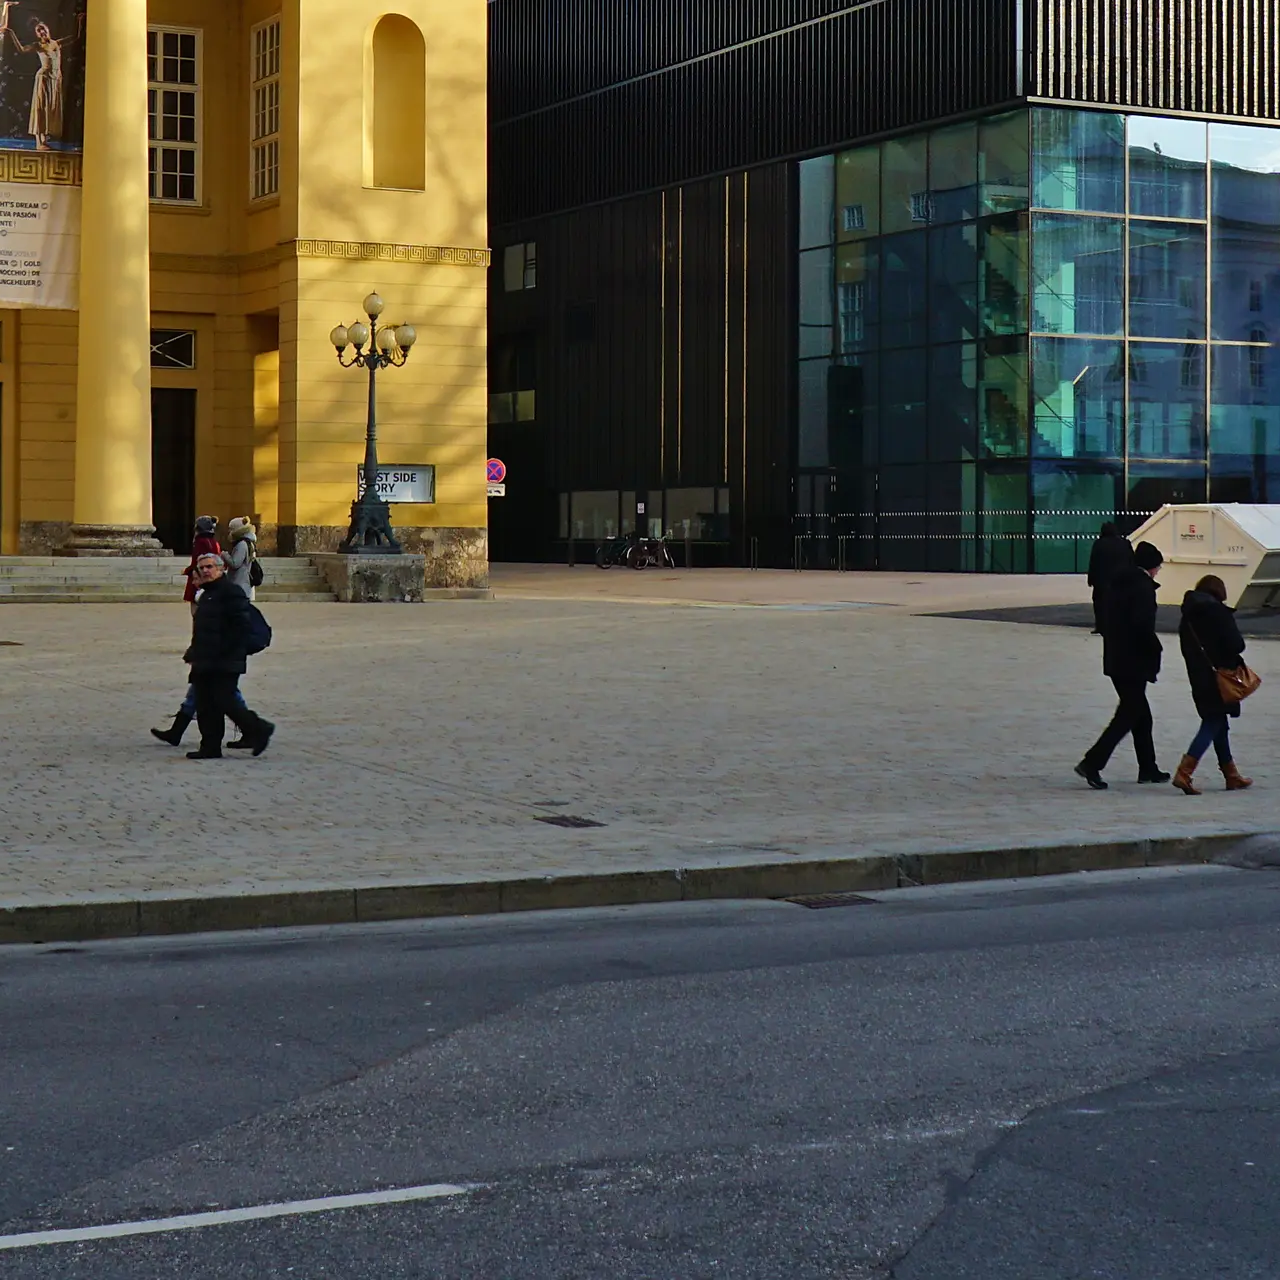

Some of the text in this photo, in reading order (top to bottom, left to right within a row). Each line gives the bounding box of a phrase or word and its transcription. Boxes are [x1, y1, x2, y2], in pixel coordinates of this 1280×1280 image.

[0, 278, 35, 286] UNGEHEUER
[393, 473, 416, 482] SIDE
[359, 484, 395, 493] SORY
